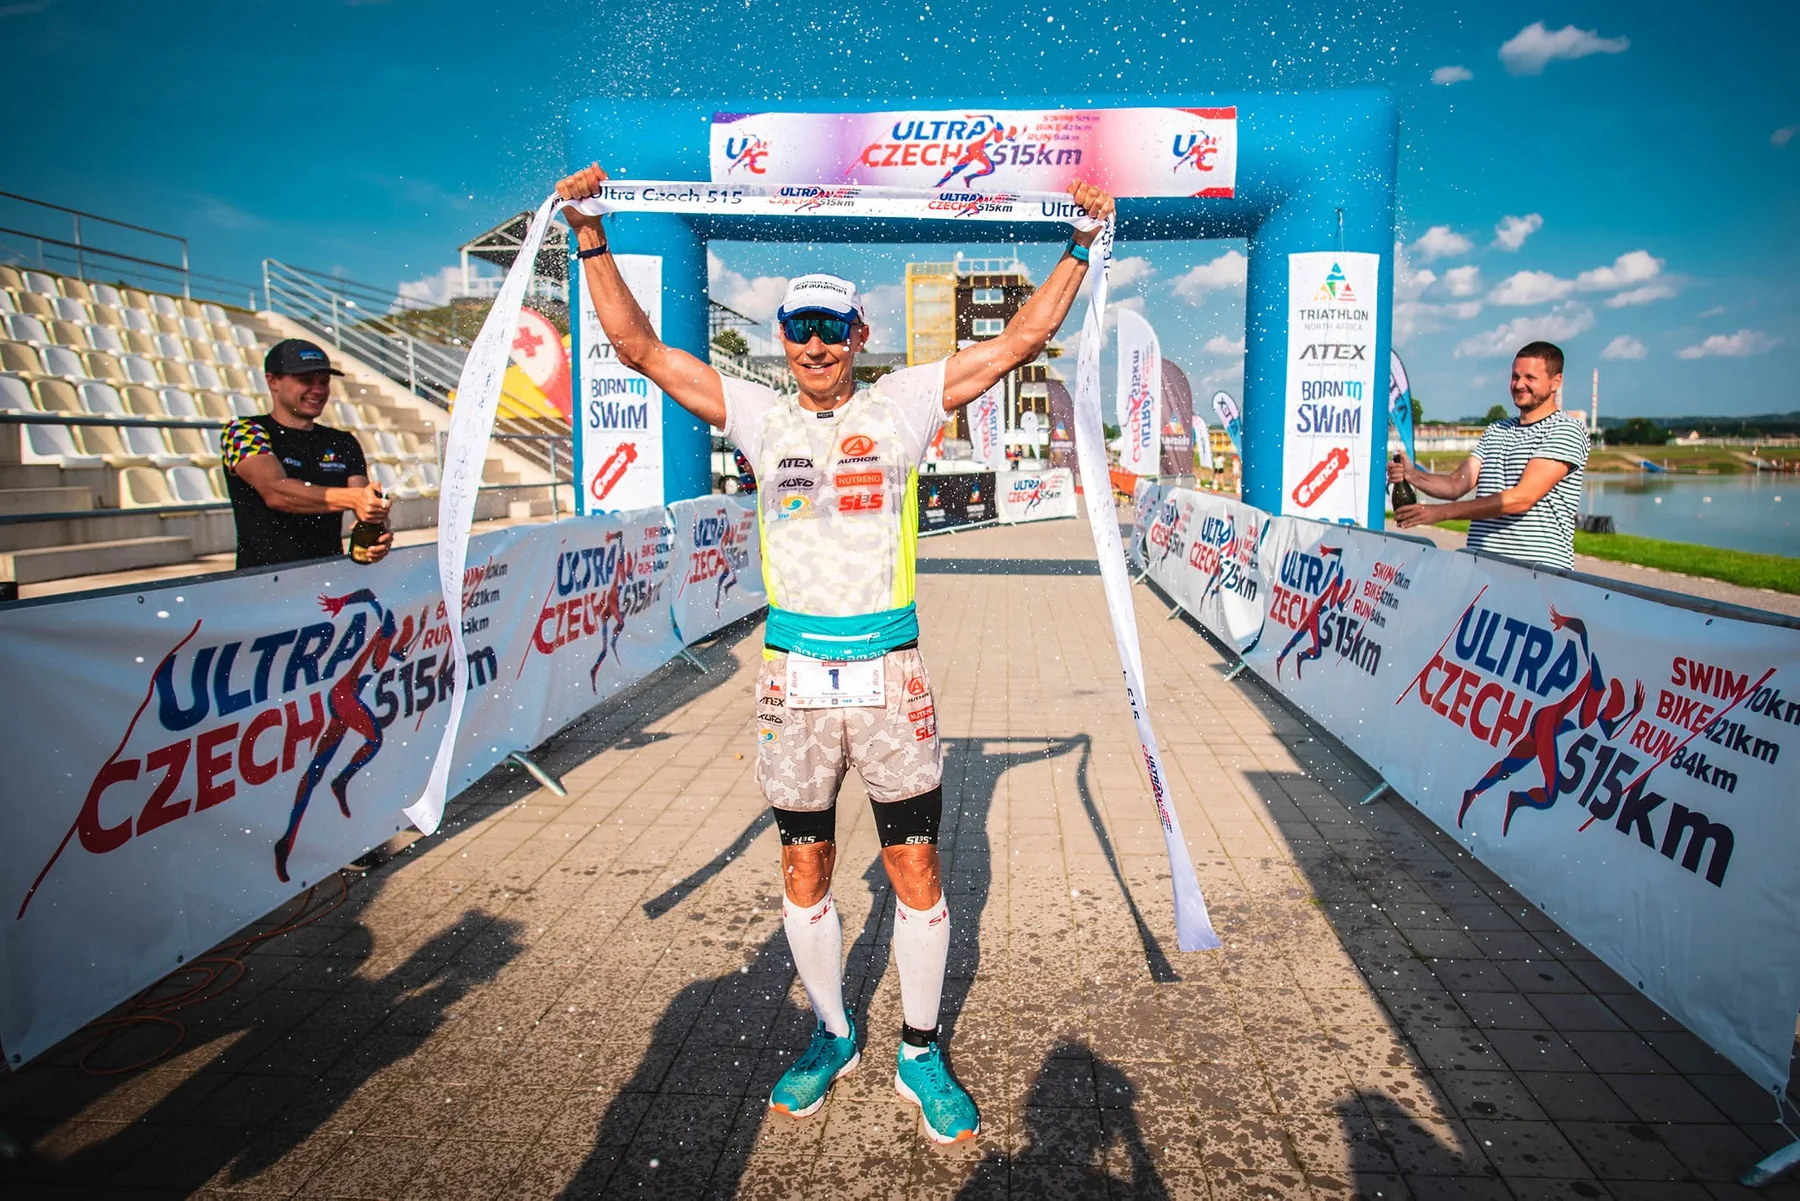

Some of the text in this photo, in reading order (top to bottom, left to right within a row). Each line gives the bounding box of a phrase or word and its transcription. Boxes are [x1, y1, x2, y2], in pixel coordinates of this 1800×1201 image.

[892, 120, 986, 141] ULTRA
[861, 144, 1082, 166] CZECH 515km
[706, 190, 742, 204] 515
[780, 187, 818, 197] ULTRA
[940, 193, 977, 202] ULTRA
[928, 201, 1013, 212] CZECH 515km
[1041, 202, 1087, 217] Ultra
[1300, 309, 1368, 321] TRIATHLON
[1305, 323, 1363, 331] NORTH AFRICA
[1299, 344, 1367, 360] ATEX
[778, 458, 813, 469] ATEX
[837, 456, 877, 465] AUTHOR
[839, 475, 880, 485] NUTREND
[1189, 541, 1220, 574] CZECH
[1281, 549, 1336, 596] ULTRA
[1372, 561, 1396, 582] SWIM
[1364, 580, 1382, 601] BIKE
[1353, 598, 1372, 619] RUN
[533, 589, 607, 654] CZECH
[423, 622, 452, 650] RUN
[1320, 612, 1382, 677] 515km
[1454, 605, 1579, 697] ULTRA
[156, 612, 369, 731] ULTRA
[829, 669, 839, 690] 1
[1671, 656, 1749, 700] SWIM
[1656, 689, 1780, 765] BIKE 421km
[1629, 720, 1738, 794] RUN 84km
[77, 692, 336, 854] CZECH
[1149, 755, 1164, 797] ULTRA
[1418, 655, 1735, 888] CZECH 515km
